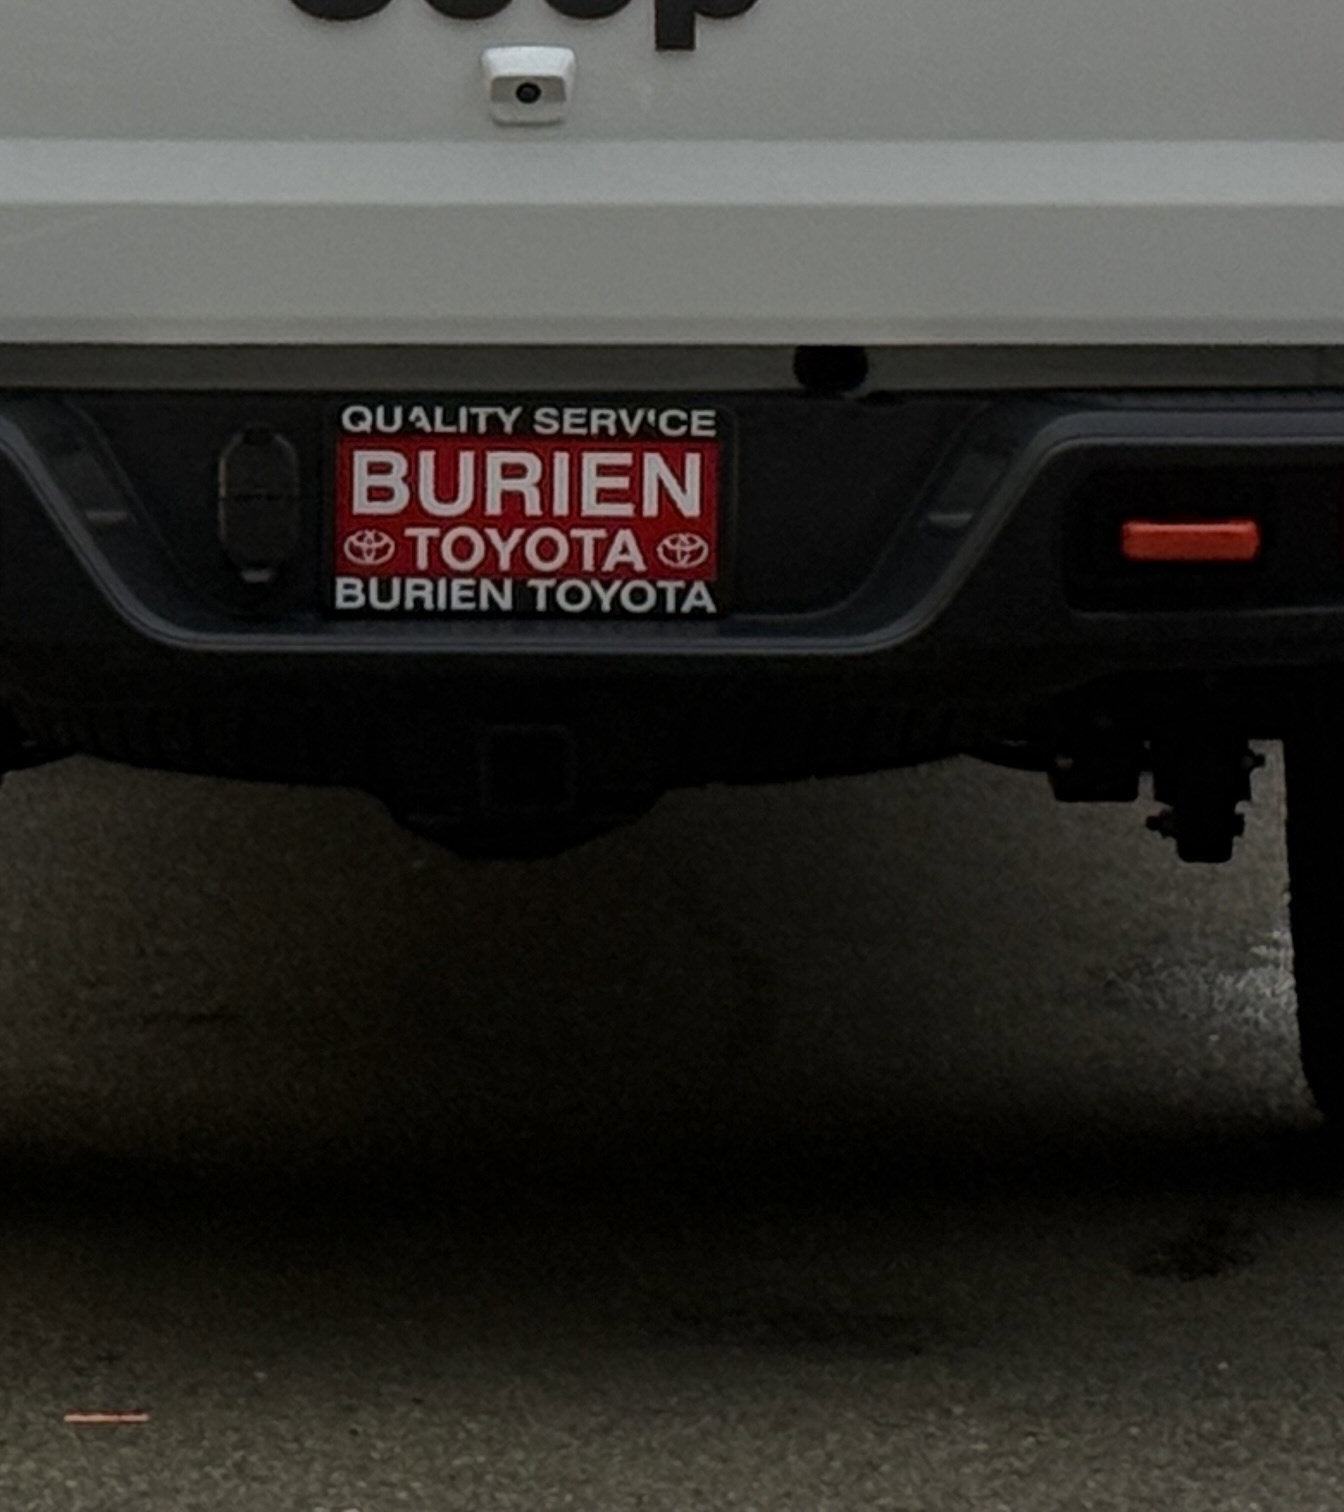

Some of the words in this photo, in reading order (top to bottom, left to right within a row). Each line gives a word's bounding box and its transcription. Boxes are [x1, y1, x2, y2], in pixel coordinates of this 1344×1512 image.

[341, 405, 523, 434] QUALITY
[353, 449, 702, 517] BURIEN
[404, 526, 647, 572] TOYOTA
[334, 577, 513, 611] BURIEN
[527, 579, 717, 614] TOYOTA
